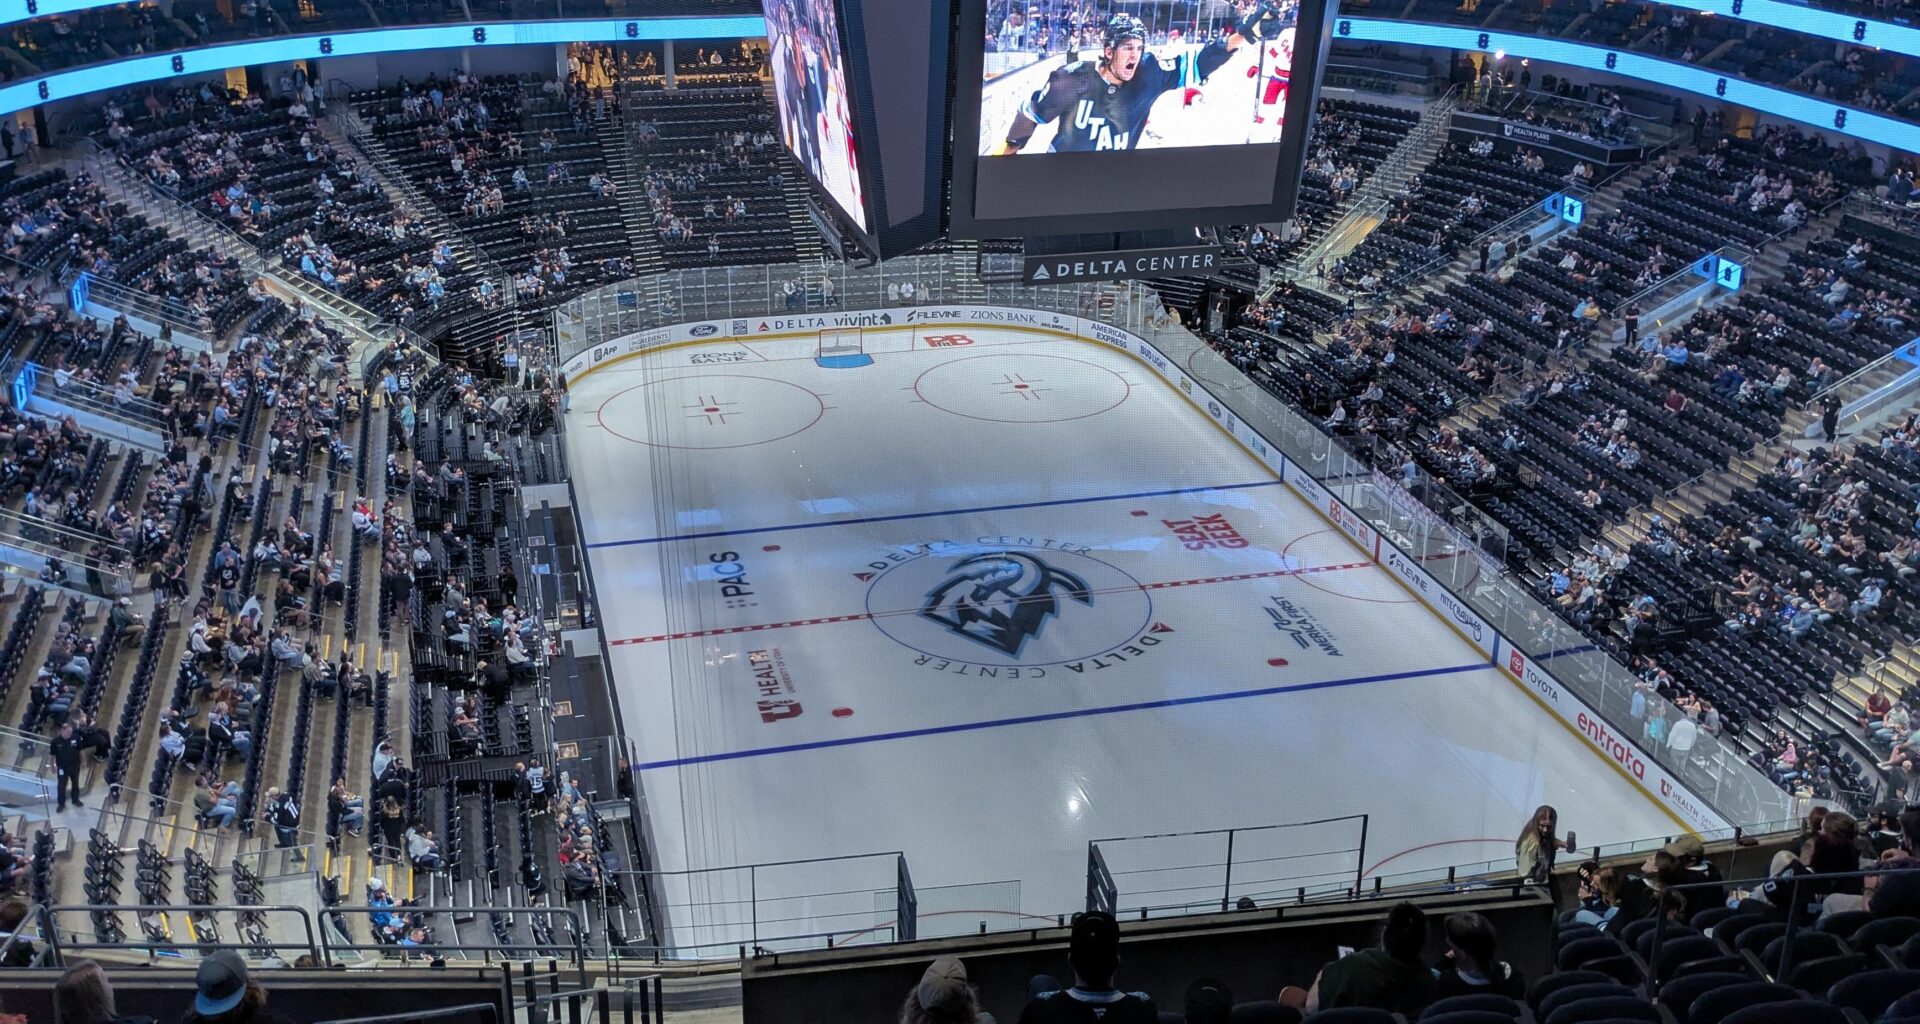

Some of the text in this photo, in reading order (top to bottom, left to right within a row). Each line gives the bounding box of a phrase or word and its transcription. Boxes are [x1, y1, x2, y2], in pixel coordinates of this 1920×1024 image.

[1281, 39, 1293, 64] CAN
[1075, 99, 1129, 151] UTAH
[1514, 127, 1533, 137] HEALTH
[1533, 132, 1550, 141] PLANS
[1057, 254, 1213, 277] DELTA CENTER
[775, 317, 825, 330] DELTA
[834, 312, 880, 327] vivint
[917, 310, 962, 320] FILEVINE
[970, 310, 1036, 323] ZIONS BANK
[631, 333, 669, 346] INGREDIENTS
[1091, 323, 1127, 341] AMERICAN
[1096, 332, 1127, 349] EXPRESS
[603, 346, 618, 357] App
[688, 350, 749, 359] ZIONS
[1140, 345, 1167, 373] BUD LIGHT
[1160, 519, 1217, 551] SEAT
[1192, 512, 1250, 549] GEEK
[868, 535, 1092, 571] DELTA CENTER
[709, 551, 754, 598] PACS
[1395, 558, 1428, 592] FILEVINE
[1271, 595, 1303, 619] FIRST
[1296, 618, 1344, 657] AMERICA
[914, 635, 1162, 679] DELTA CENTER
[747, 649, 783, 697] HEALTH
[1526, 667, 1559, 703] TOYOTA
[1577, 712, 1646, 781] entrata
[1673, 791, 1699, 818] HEALTH
